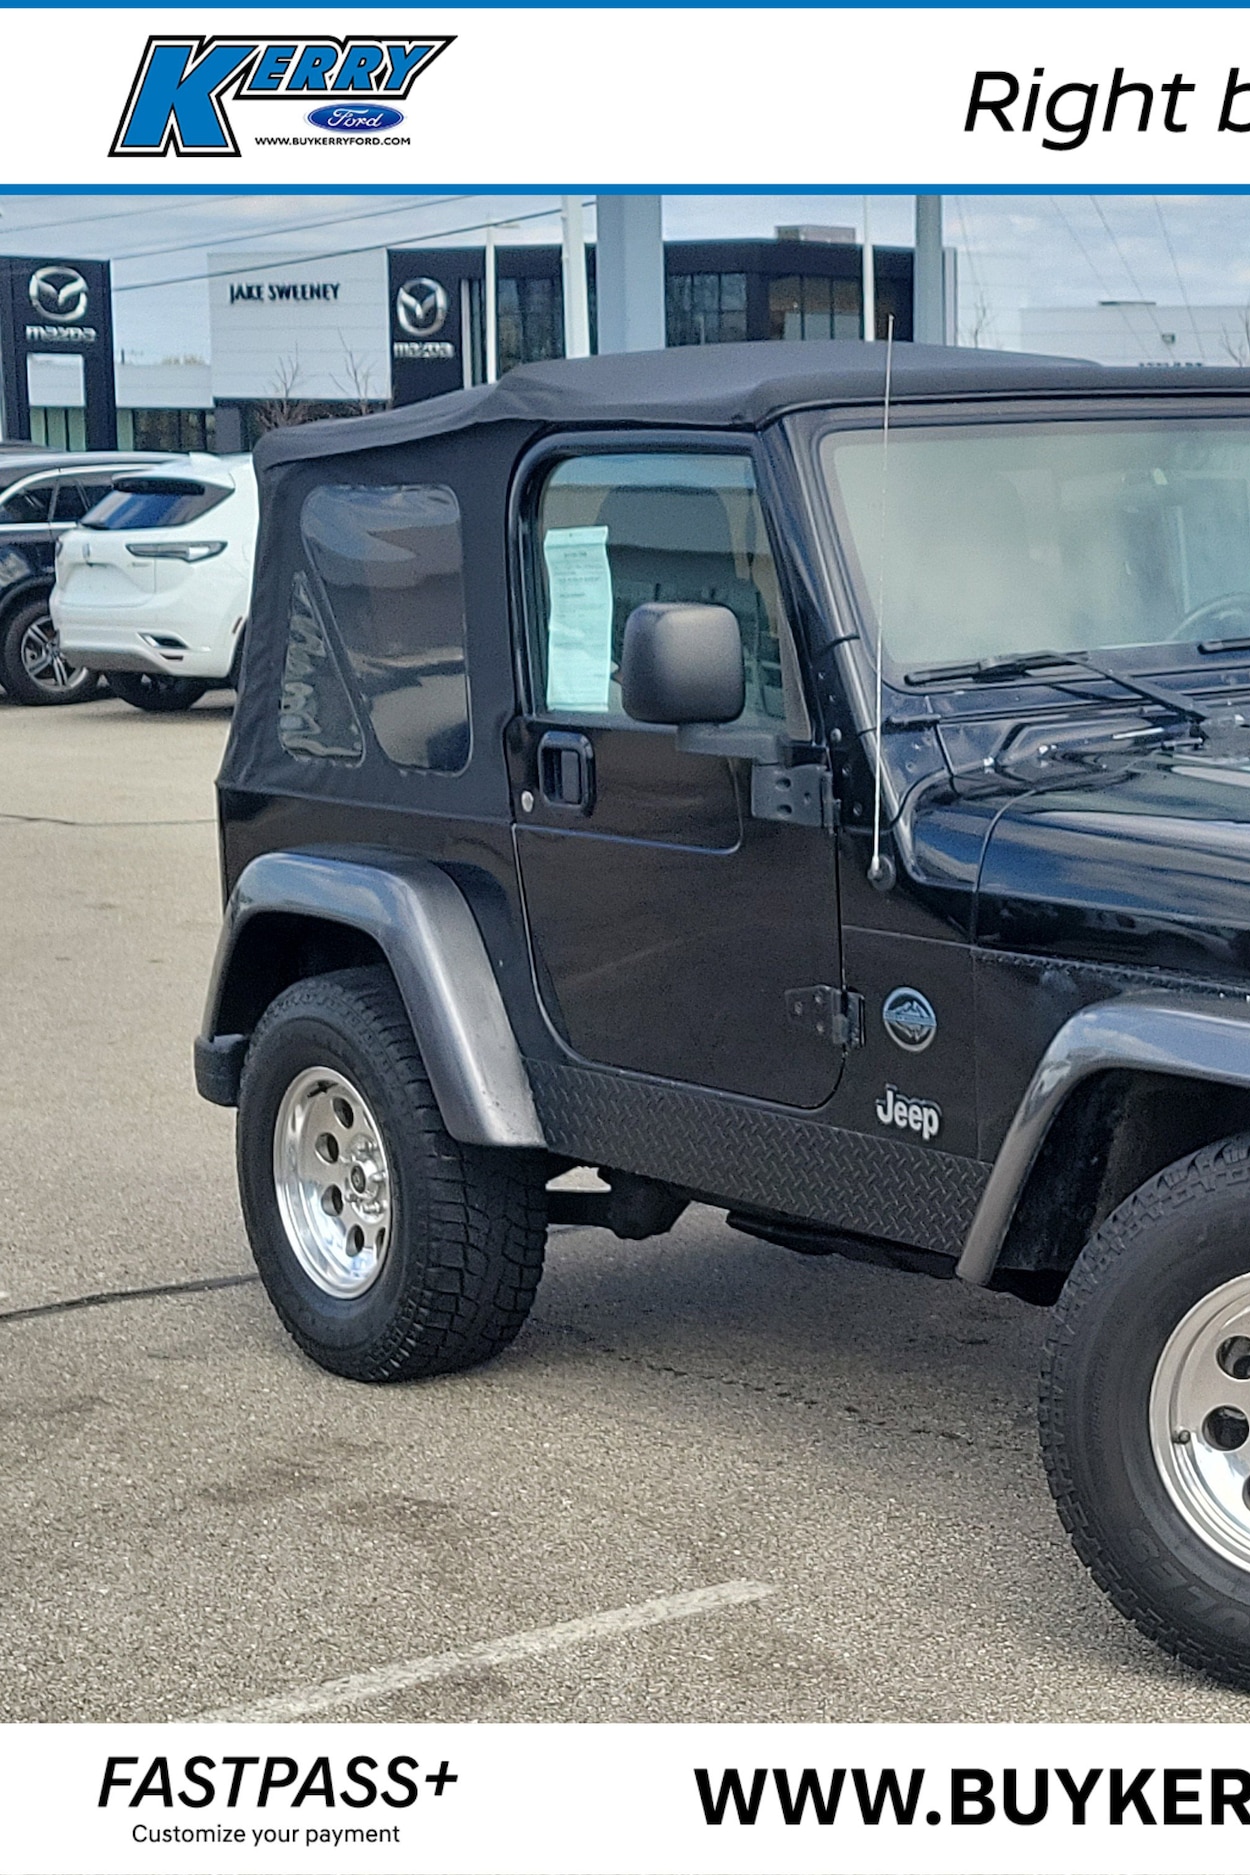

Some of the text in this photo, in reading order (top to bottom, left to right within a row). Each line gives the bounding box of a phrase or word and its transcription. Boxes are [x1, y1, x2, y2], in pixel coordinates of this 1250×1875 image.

[229, 282, 340, 305] JAKE SWEENEY
[876, 1084, 942, 1140] Jeep
